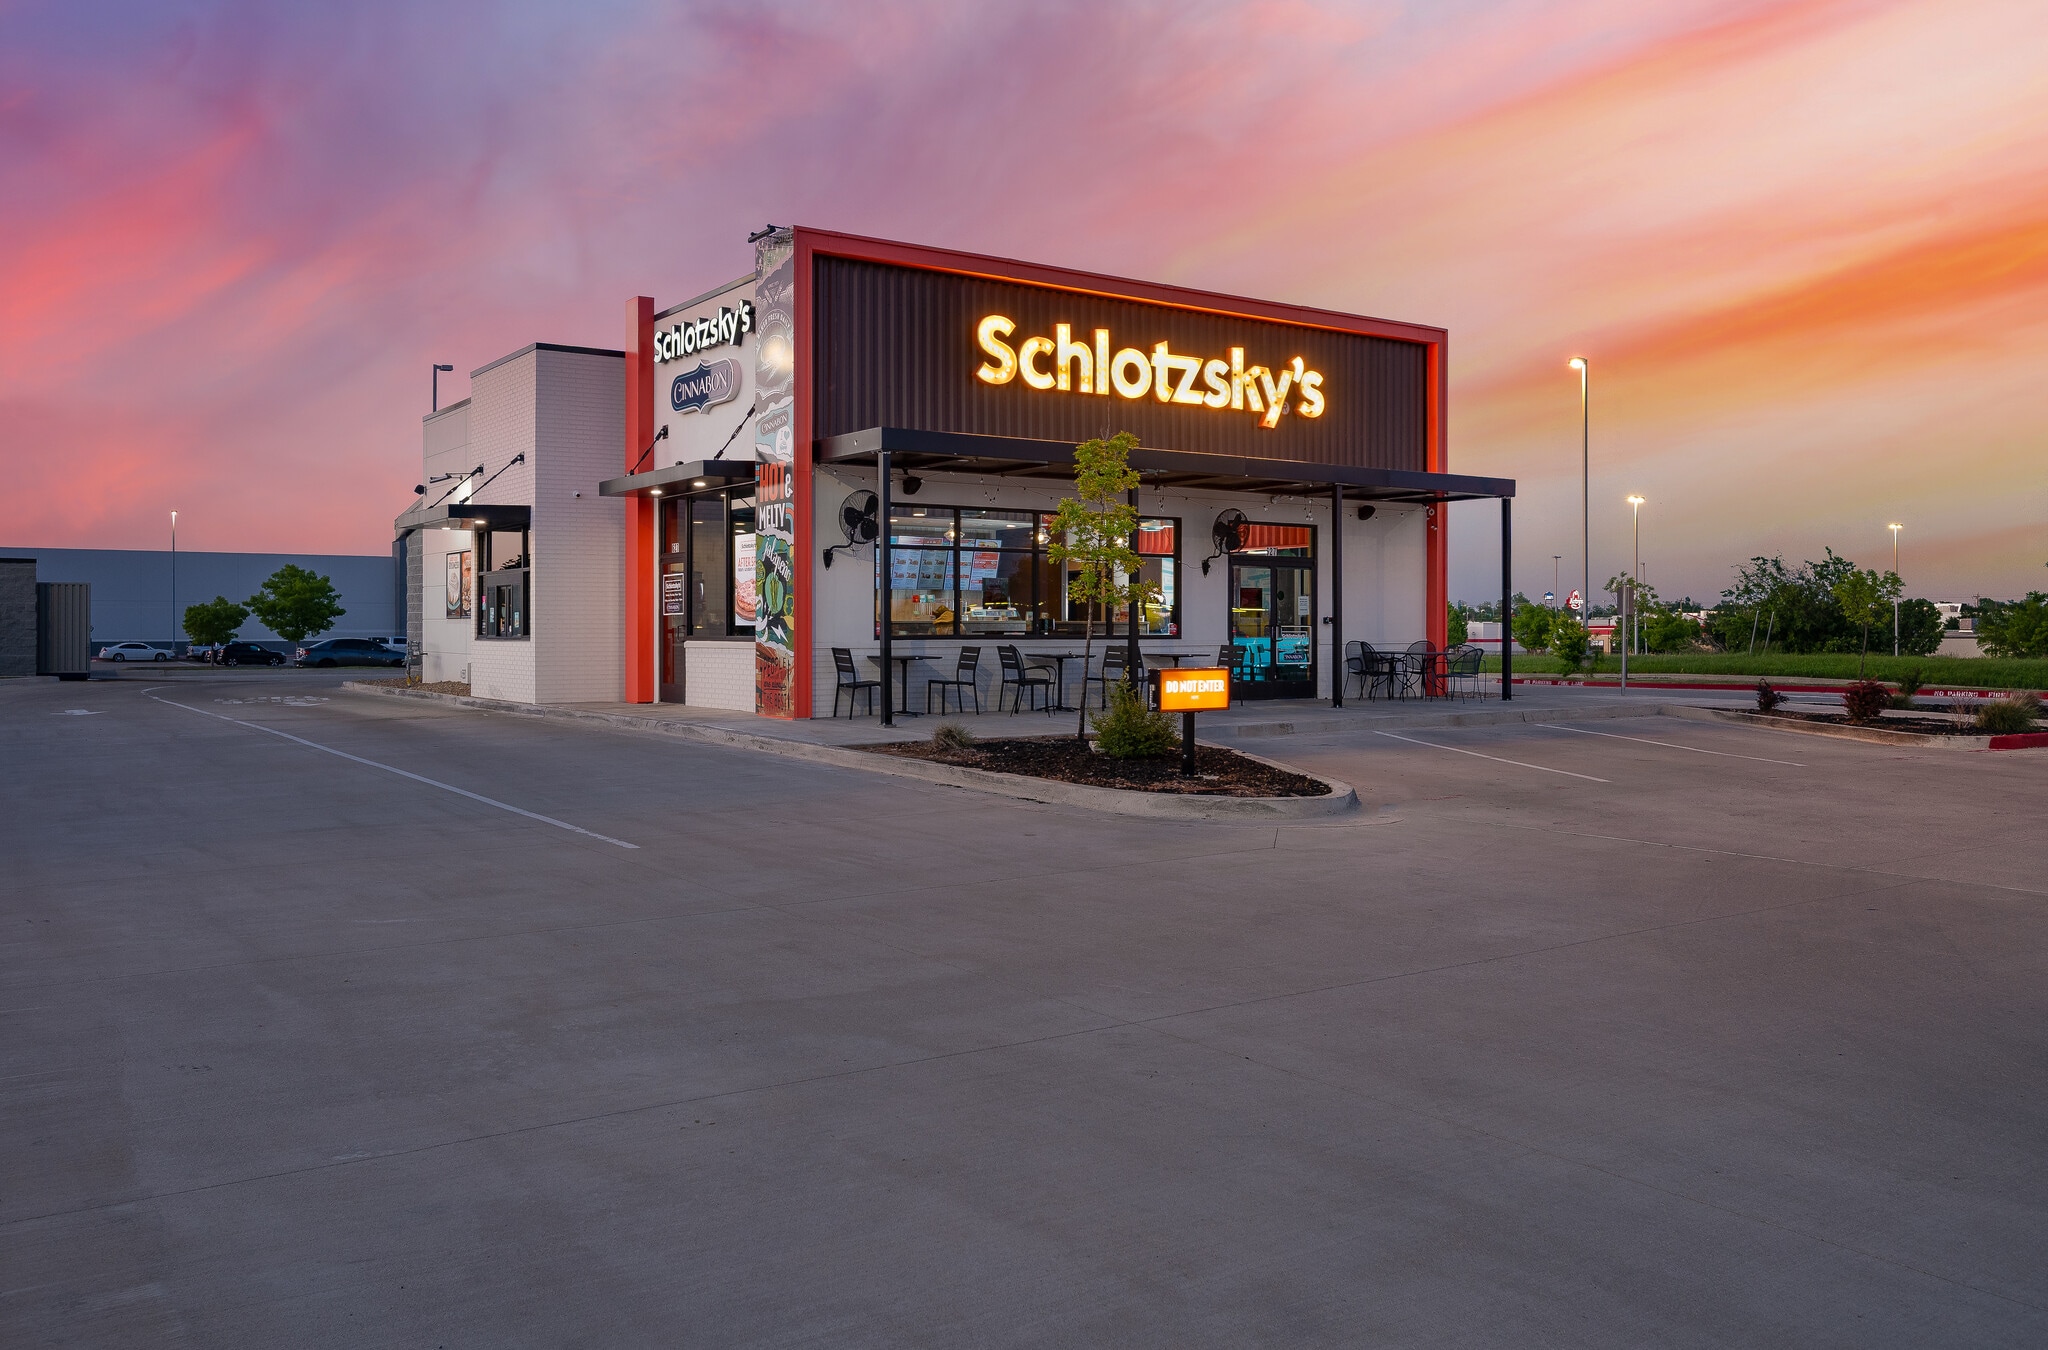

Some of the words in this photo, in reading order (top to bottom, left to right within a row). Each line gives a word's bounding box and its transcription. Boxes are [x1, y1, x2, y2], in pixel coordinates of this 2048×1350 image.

[654, 300, 751, 363] Schlotzsky's
[674, 369, 728, 404] CINNABON
[975, 314, 1325, 429] Schlotzsky's
[759, 461, 787, 503] HOT
[759, 503, 786, 530] MELTY
[1165, 680, 1179, 694] DO
[1179, 680, 1198, 693] NOT
[1198, 679, 1225, 692] ENTER
[1947, 690, 1979, 698] PARKING
